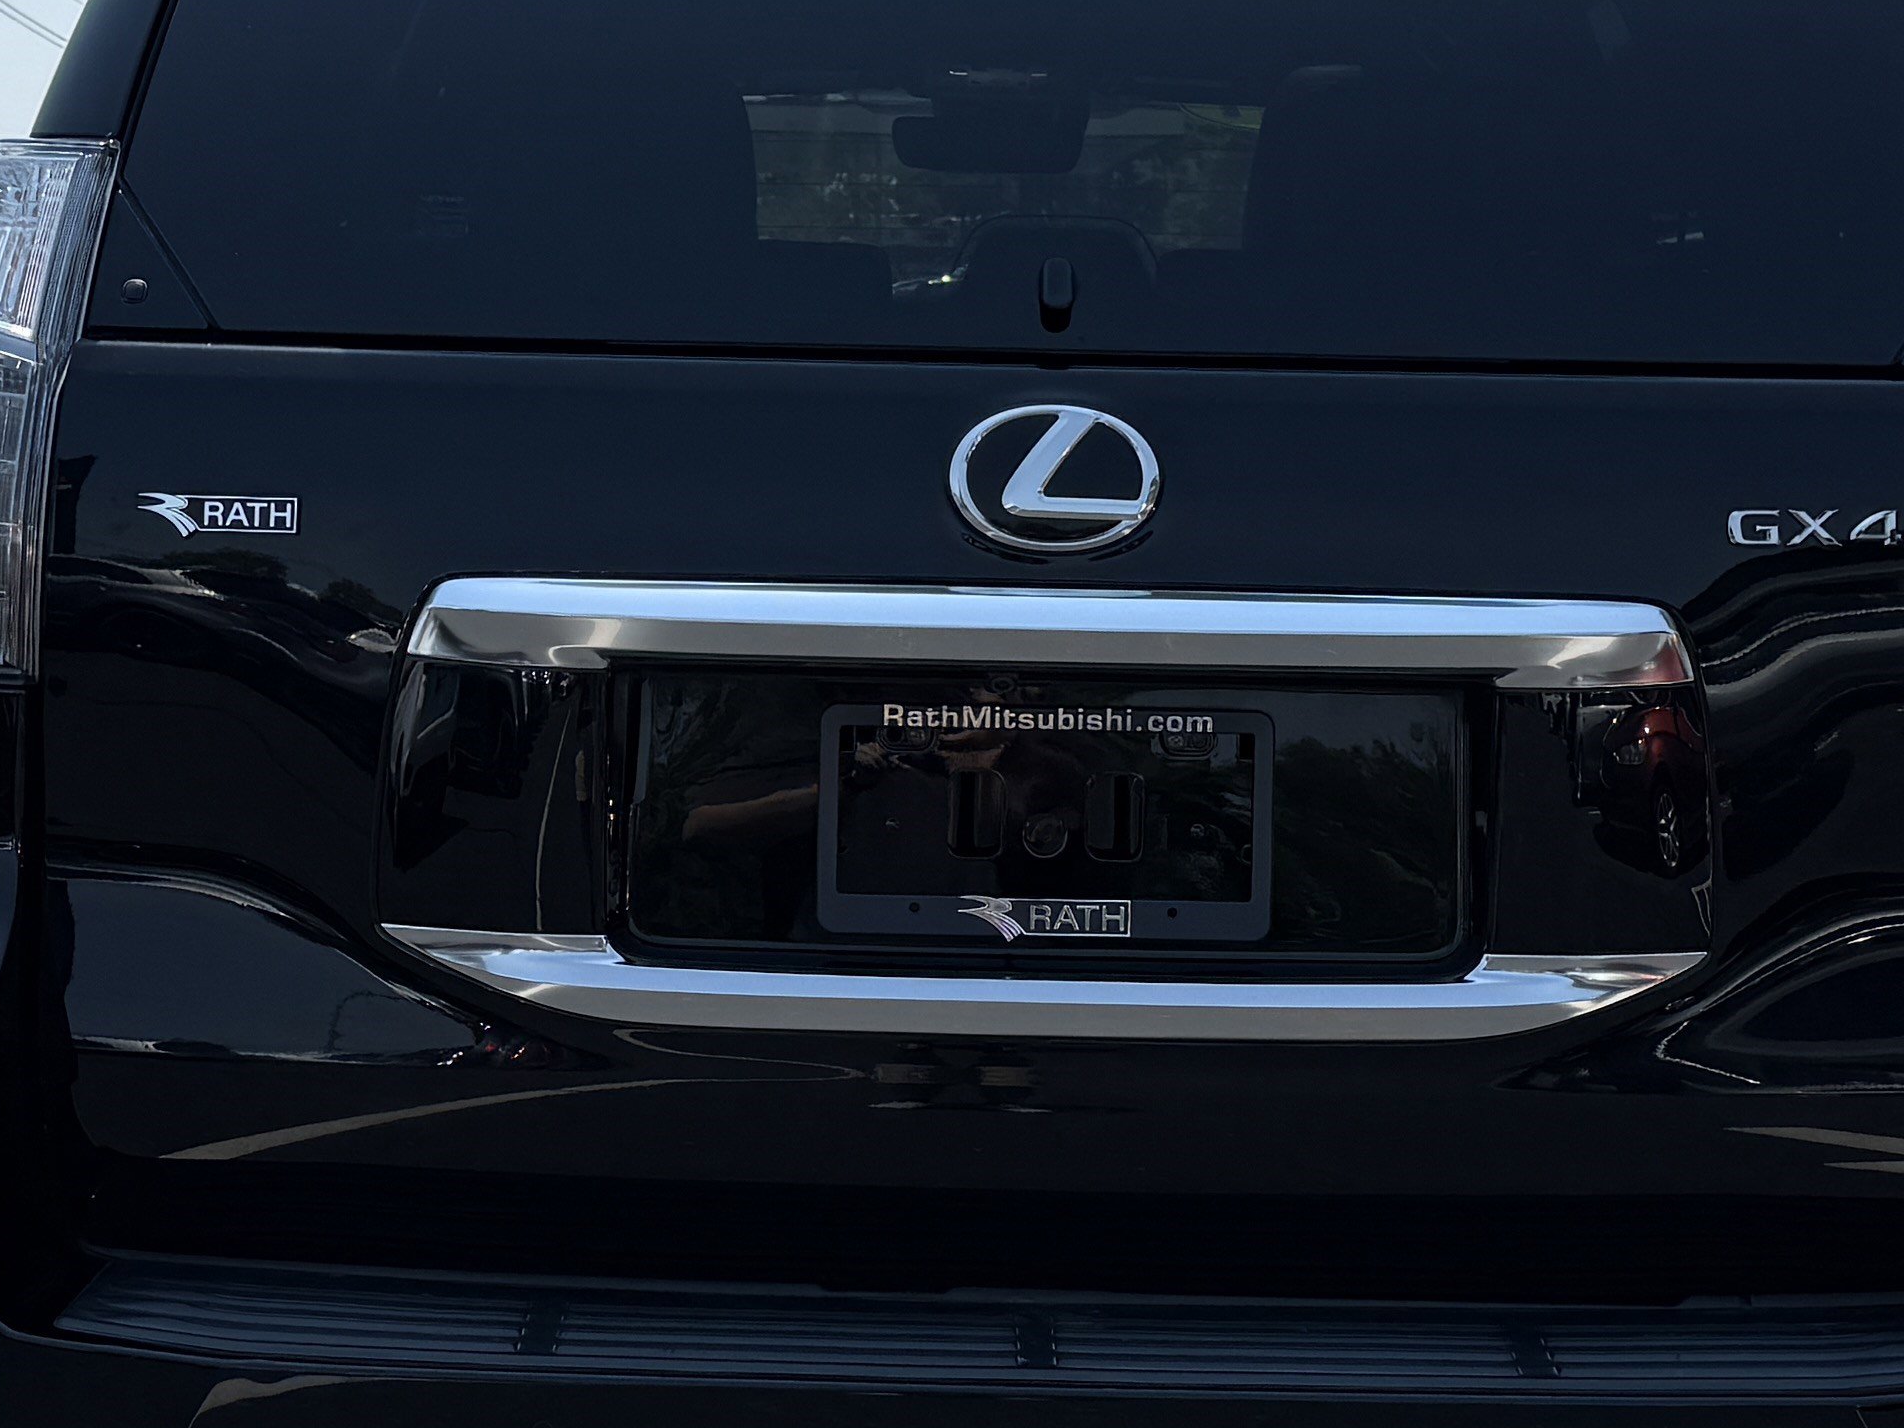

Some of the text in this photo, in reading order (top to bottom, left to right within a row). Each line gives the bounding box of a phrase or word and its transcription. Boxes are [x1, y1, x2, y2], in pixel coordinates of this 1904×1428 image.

[203, 501, 292, 529] RATH
[882, 704, 1214, 733] RathMitsubishi.com
[1029, 904, 1126, 932] RATH
